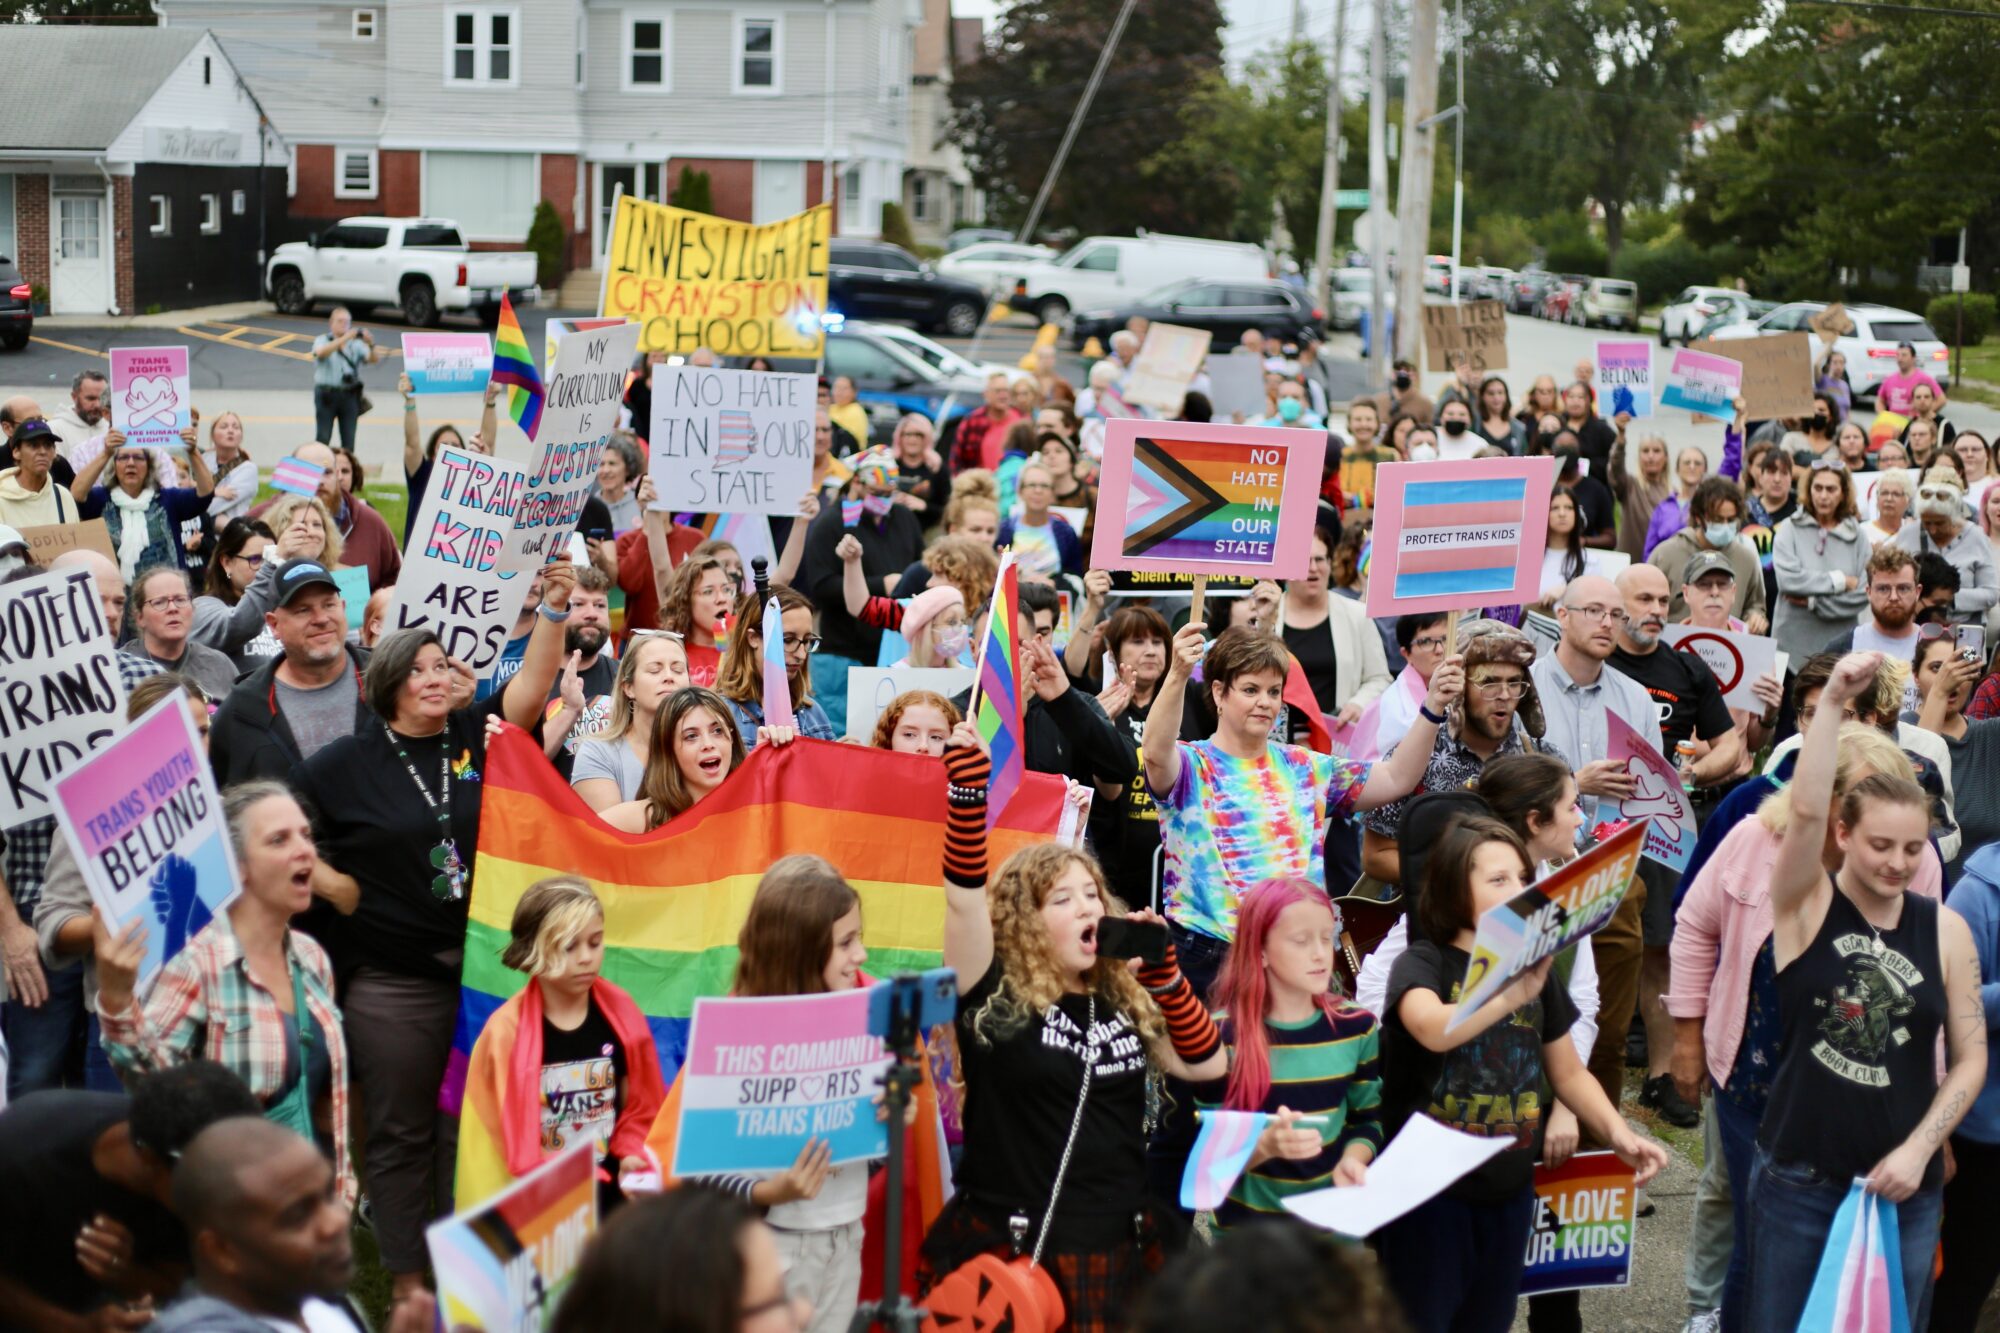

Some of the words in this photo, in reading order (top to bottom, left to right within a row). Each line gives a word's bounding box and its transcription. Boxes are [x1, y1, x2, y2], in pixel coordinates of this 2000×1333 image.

[617, 204, 825, 282] INVESTIGATE
[614, 274, 818, 320] CRANSTON
[131, 357, 169, 365] TRANS
[586, 338, 608, 365] MY
[128, 365, 172, 374] RIGHTS
[1601, 368, 1648, 384] BELONG
[547, 369, 629, 410] CURRICULUM
[674, 372, 724, 408] NO
[737, 374, 801, 408] HATE
[579, 413, 592, 434] IS
[661, 416, 709, 458] IN
[763, 419, 811, 459] OUR
[529, 435, 610, 488] JUSTIC
[1250, 449, 1280, 465] NO
[688, 469, 776, 506] STATE
[1231, 471, 1278, 487] HATE
[1254, 496, 1274, 512] IN
[24, 529, 77, 549] ODILY
[1231, 518, 1271, 535] OUR
[1405, 532, 1453, 546] PROTECT
[1456, 530, 1489, 543] TRANS
[1491, 528, 1515, 540] KIDS
[424, 510, 519, 581] KID
[522, 533, 545, 556] and
[1214, 539, 1268, 555] STATE
[1131, 571, 1171, 584] Silent
[424, 582, 500, 619] ARE
[0, 571, 103, 666] ROTECT
[1706, 660, 1727, 670] OME
[85, 788, 146, 846] TRANS
[142, 747, 194, 803] YOUTH
[99, 776, 208, 893] BELONG
[1647, 834, 1683, 857] UMAN
[1522, 895, 1565, 938] WE
[1566, 852, 1632, 917] LOVE
[1562, 886, 1624, 941] KIDS
[1880, 951, 1918, 981] ADERS
[714, 1046, 766, 1074] THIS
[1095, 1061, 1125, 1076] mood
[1820, 1047, 1852, 1075] BOOK
[546, 1092, 605, 1115] VANS
[1428, 1091, 1541, 1124] STAR
[736, 1110, 808, 1137] TRANS
[812, 1101, 857, 1134] KIDS
[1532, 1195, 1553, 1230] E
[1558, 1188, 1626, 1225] LOVE
[1523, 1231, 1557, 1267] UR
[1563, 1224, 1627, 1261] KIDS
